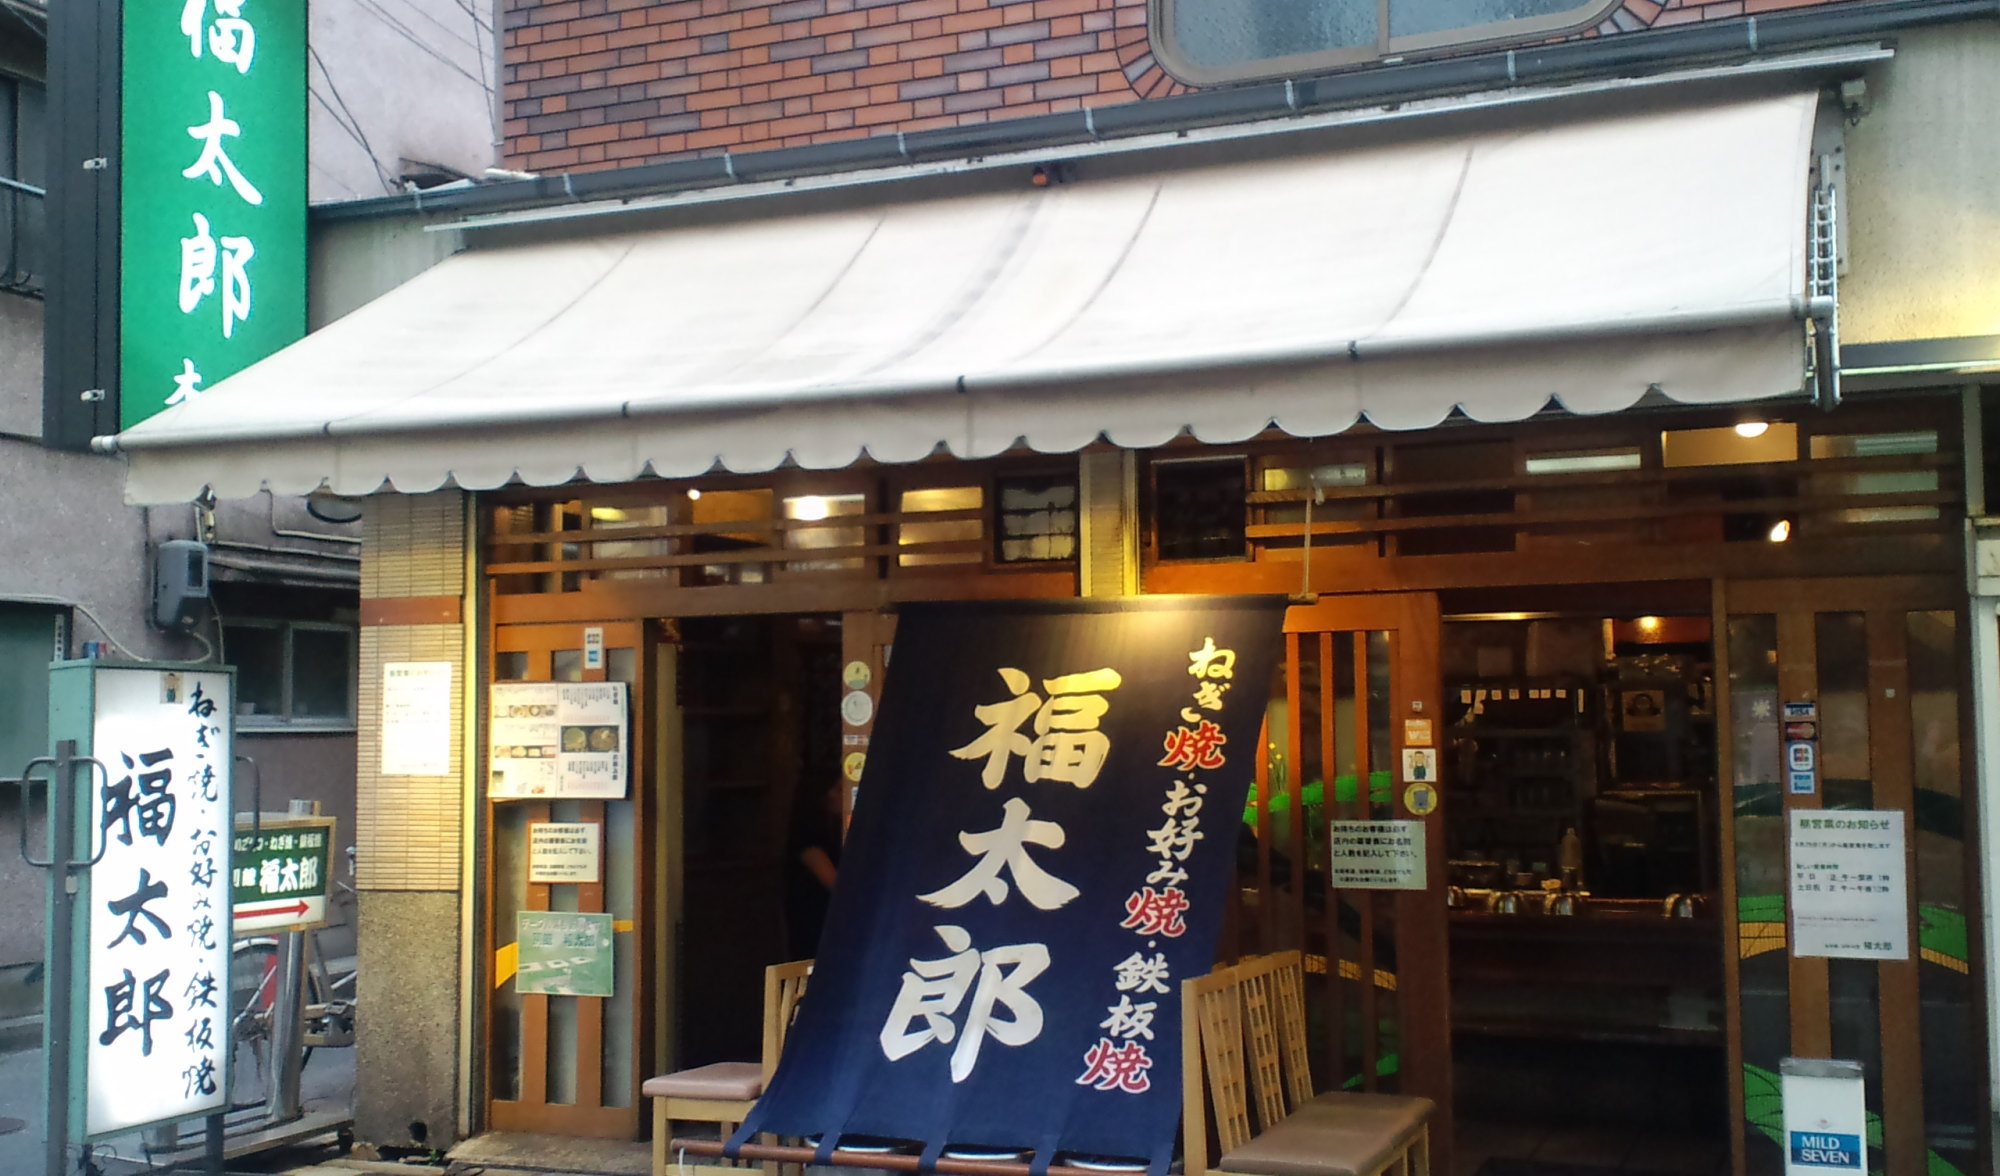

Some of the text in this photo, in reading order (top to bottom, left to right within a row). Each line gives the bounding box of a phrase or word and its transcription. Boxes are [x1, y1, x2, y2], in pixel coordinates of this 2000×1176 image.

[178, 0, 264, 339] 福太郎
[99, 747, 176, 1057] 福太郎
[879, 667, 1122, 1083] 福太郎
[1075, 637, 1236, 1093] ねぎ焼・お好み焼・鉄板焼
[1801, 1135, 1840, 1150] MILD
[1801, 1150, 1850, 1164] SEVEN
